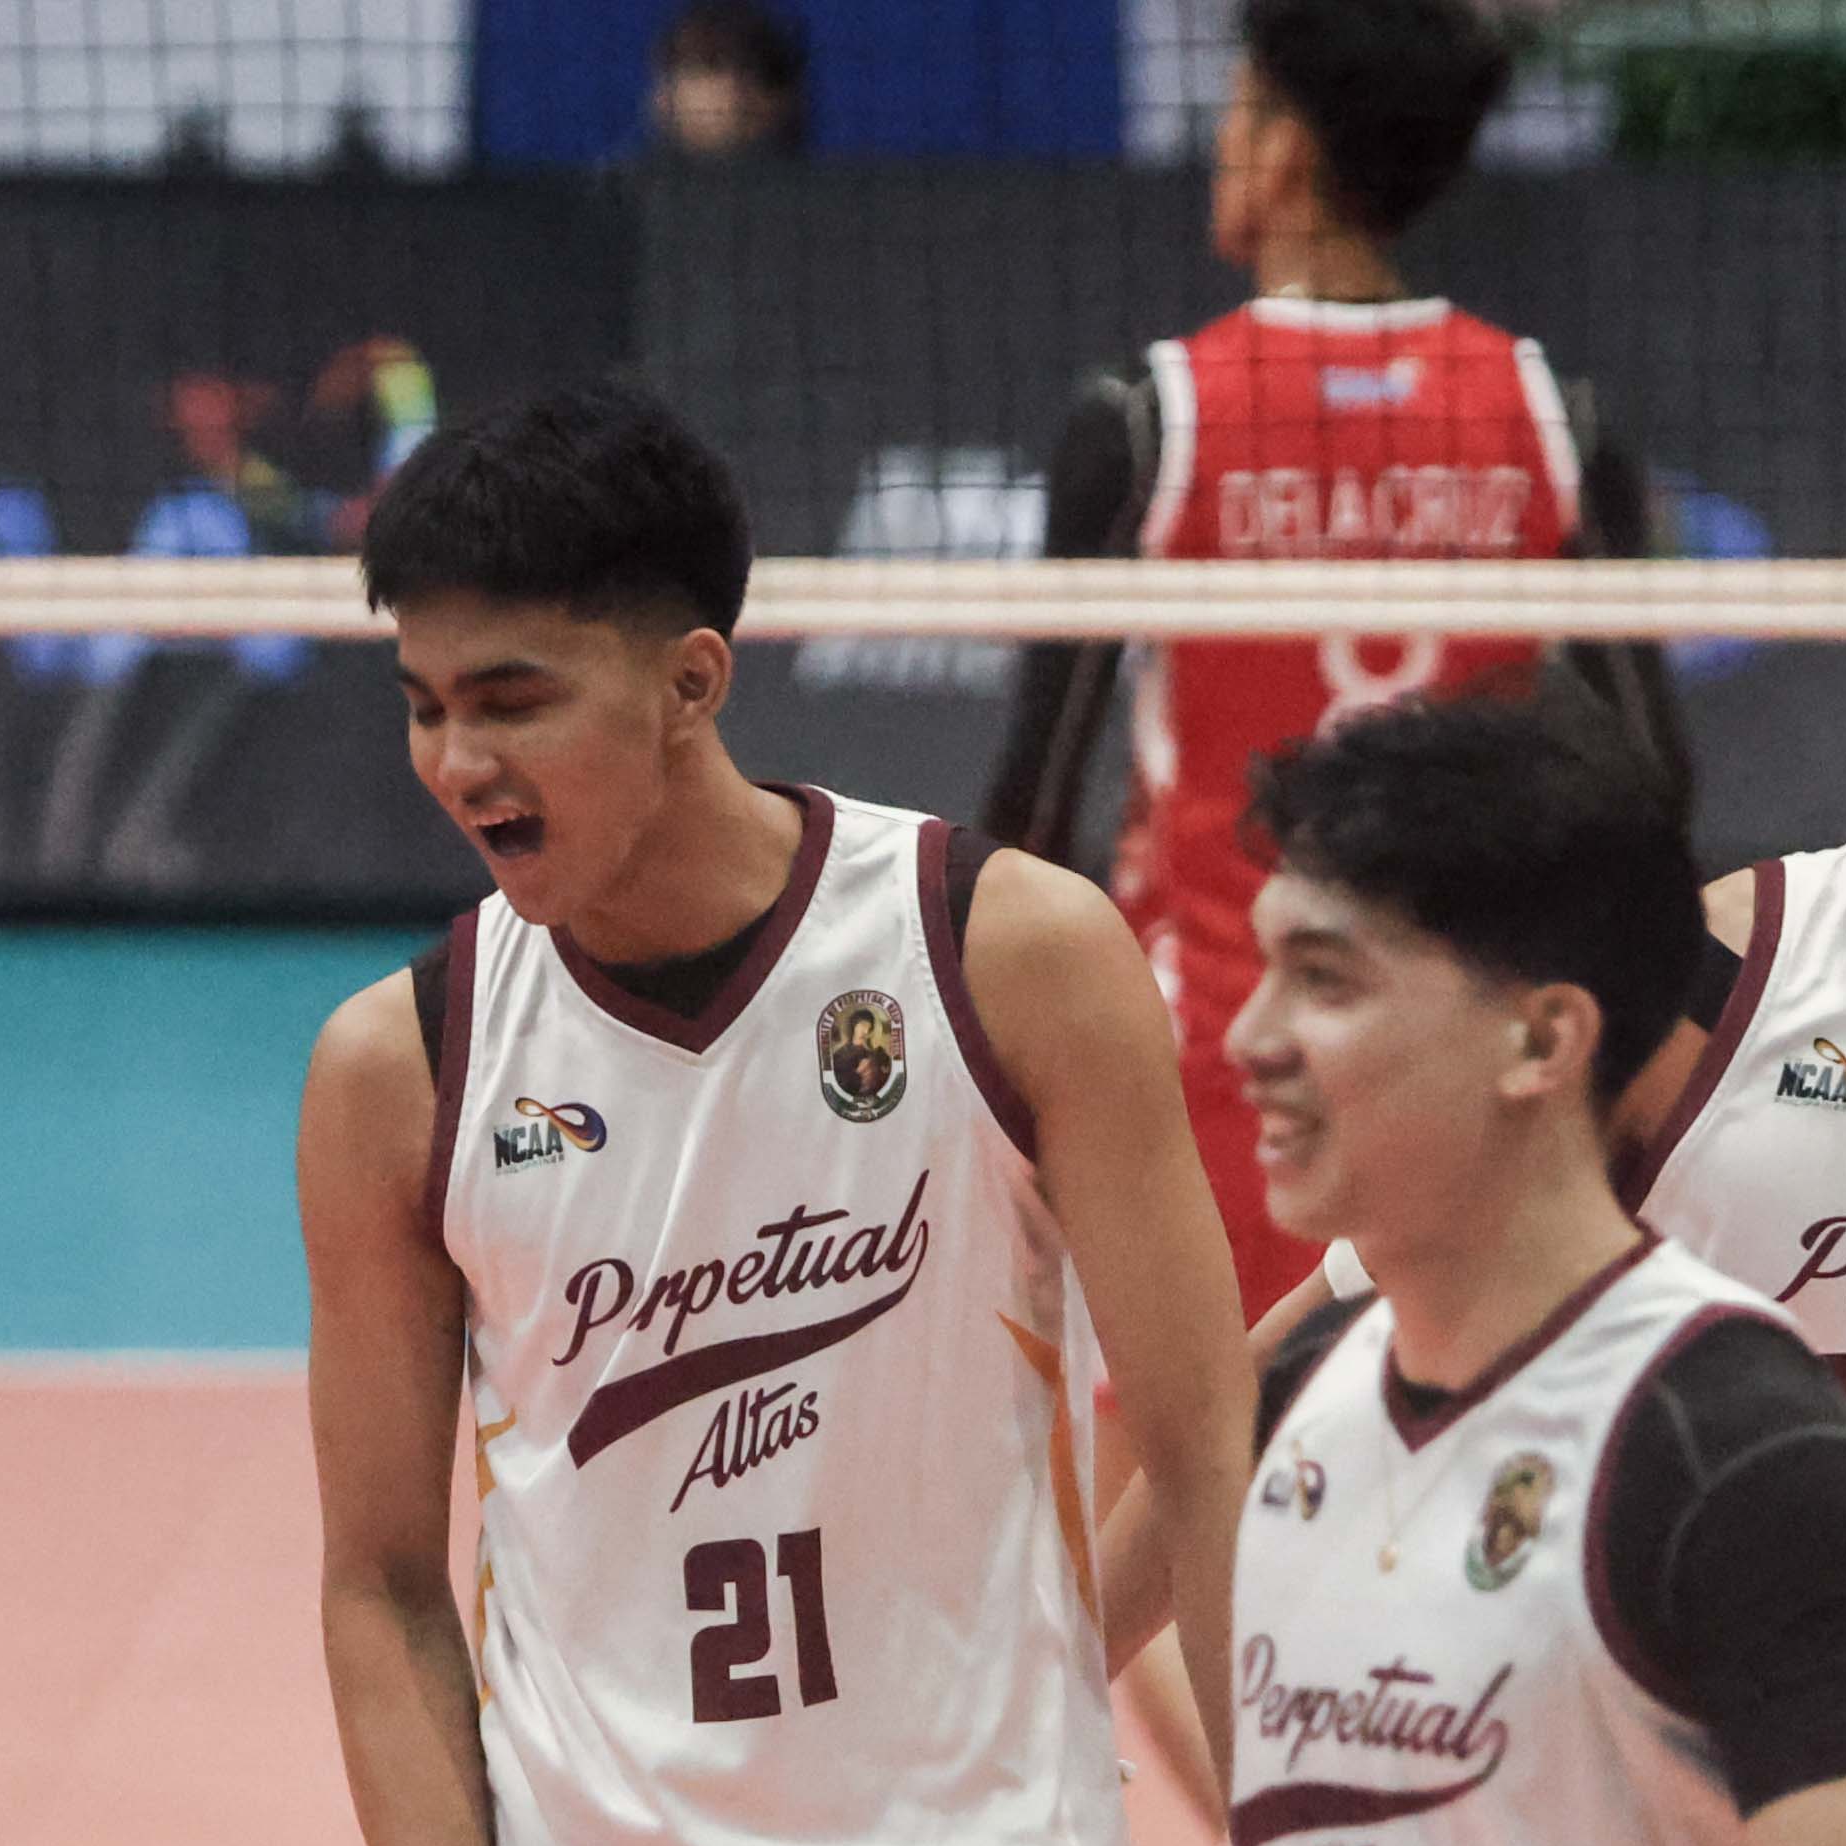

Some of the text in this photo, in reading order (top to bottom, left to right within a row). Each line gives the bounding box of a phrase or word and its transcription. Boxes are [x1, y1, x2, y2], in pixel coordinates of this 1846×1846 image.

[494, 1121, 563, 1168] NCAA
[669, 1383, 819, 1513] Altas
[684, 1527, 838, 1723] 21
[1239, 1633, 1513, 1772] Perpetual
